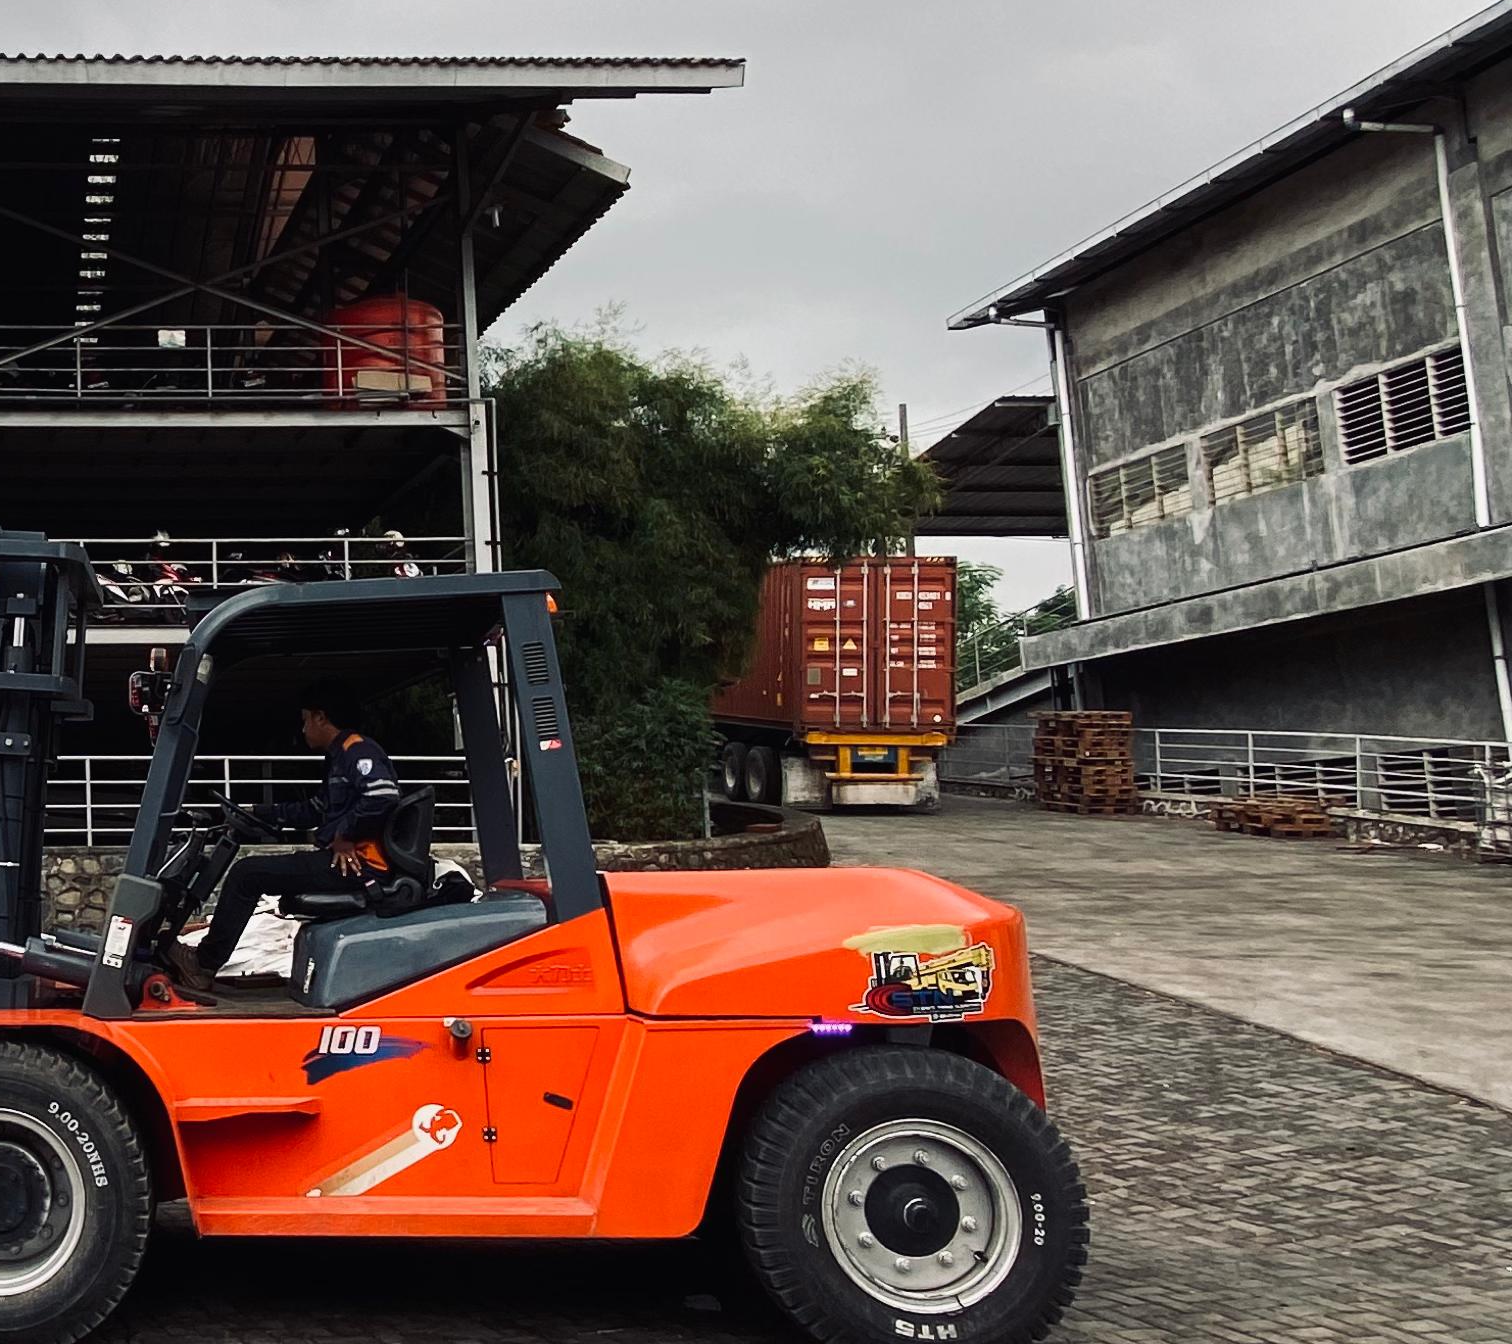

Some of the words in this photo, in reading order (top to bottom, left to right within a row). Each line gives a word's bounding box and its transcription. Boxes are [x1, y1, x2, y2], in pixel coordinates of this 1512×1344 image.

[318, 1025, 382, 1054] 100
[802, 1123, 850, 1205] TIRON
[1030, 1193, 1045, 1246] 9.00-20
[895, 1319, 957, 1340] HTS
